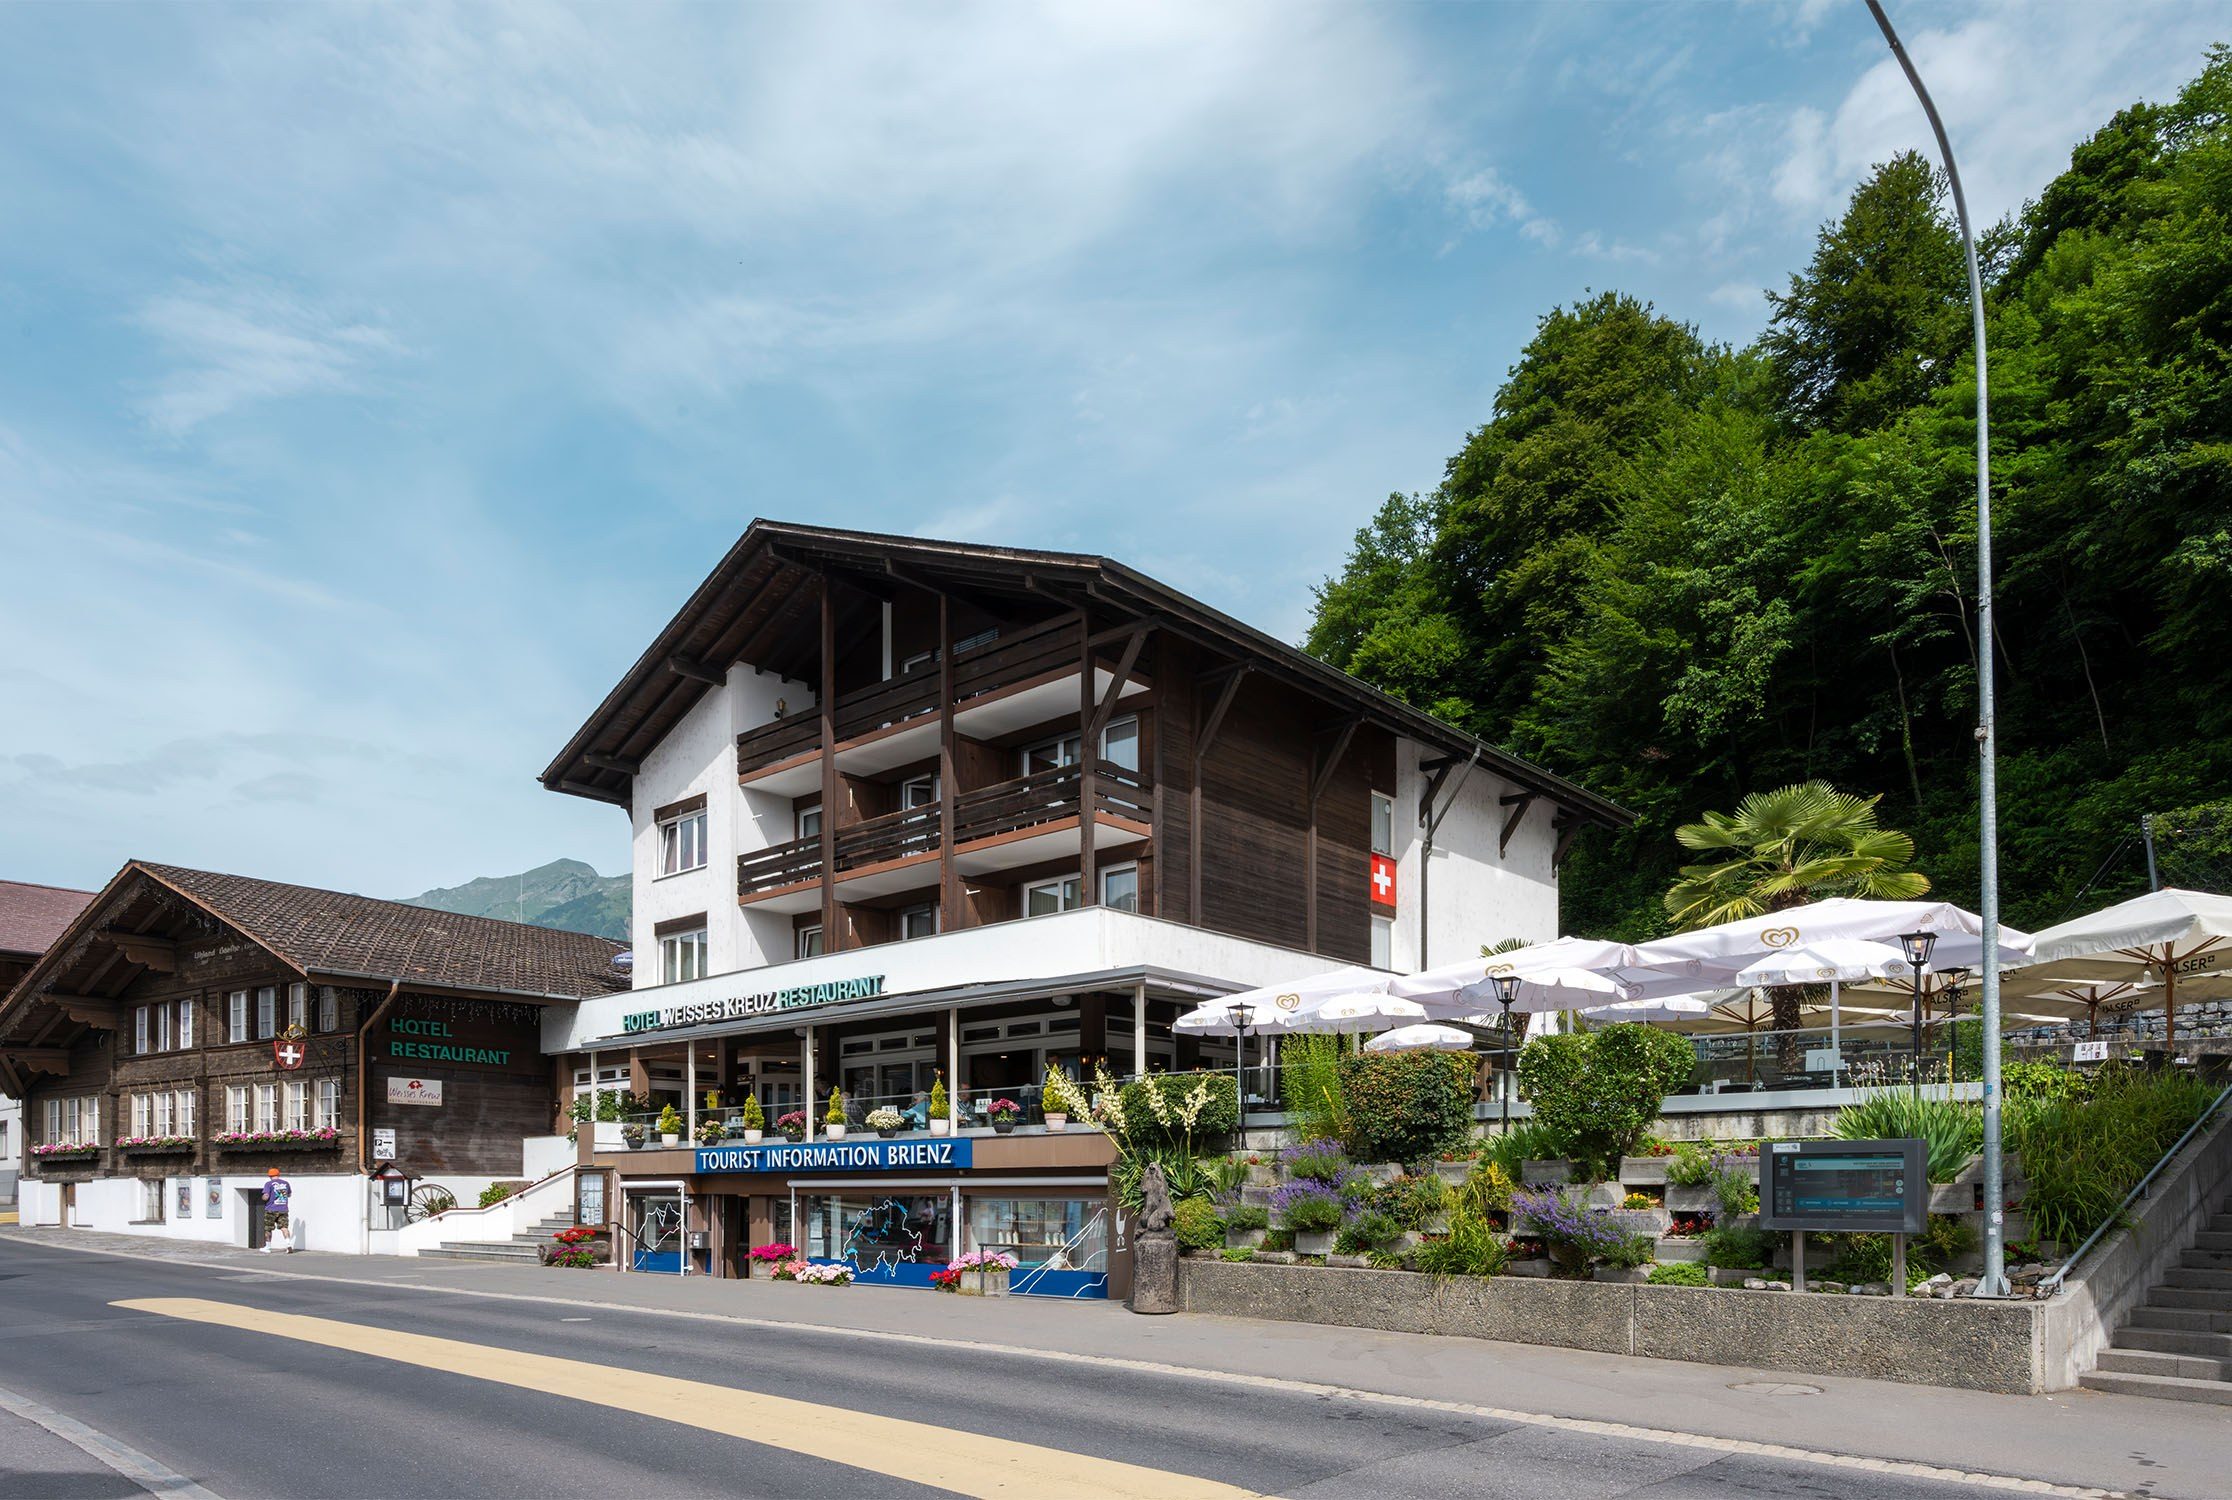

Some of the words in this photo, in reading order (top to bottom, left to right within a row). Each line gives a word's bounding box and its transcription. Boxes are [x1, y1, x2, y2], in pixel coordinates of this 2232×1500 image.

[623, 1009, 660, 1031] HOTEL
[663, 1000, 723, 1025] WEISSES
[724, 991, 776, 1017] KREUZ
[777, 974, 884, 1007] RESTAURANT
[1922, 992, 1962, 1006] ALSR
[391, 1018, 453, 1038] HOTEL
[391, 1041, 511, 1065] RESTAURANT
[389, 1087, 416, 1099] Weisses
[419, 1089, 440, 1100] Kreuz
[700, 1150, 760, 1170] TOURIST
[766, 1146, 880, 1168] INFORMATION
[888, 1143, 952, 1165] BRIENZ
